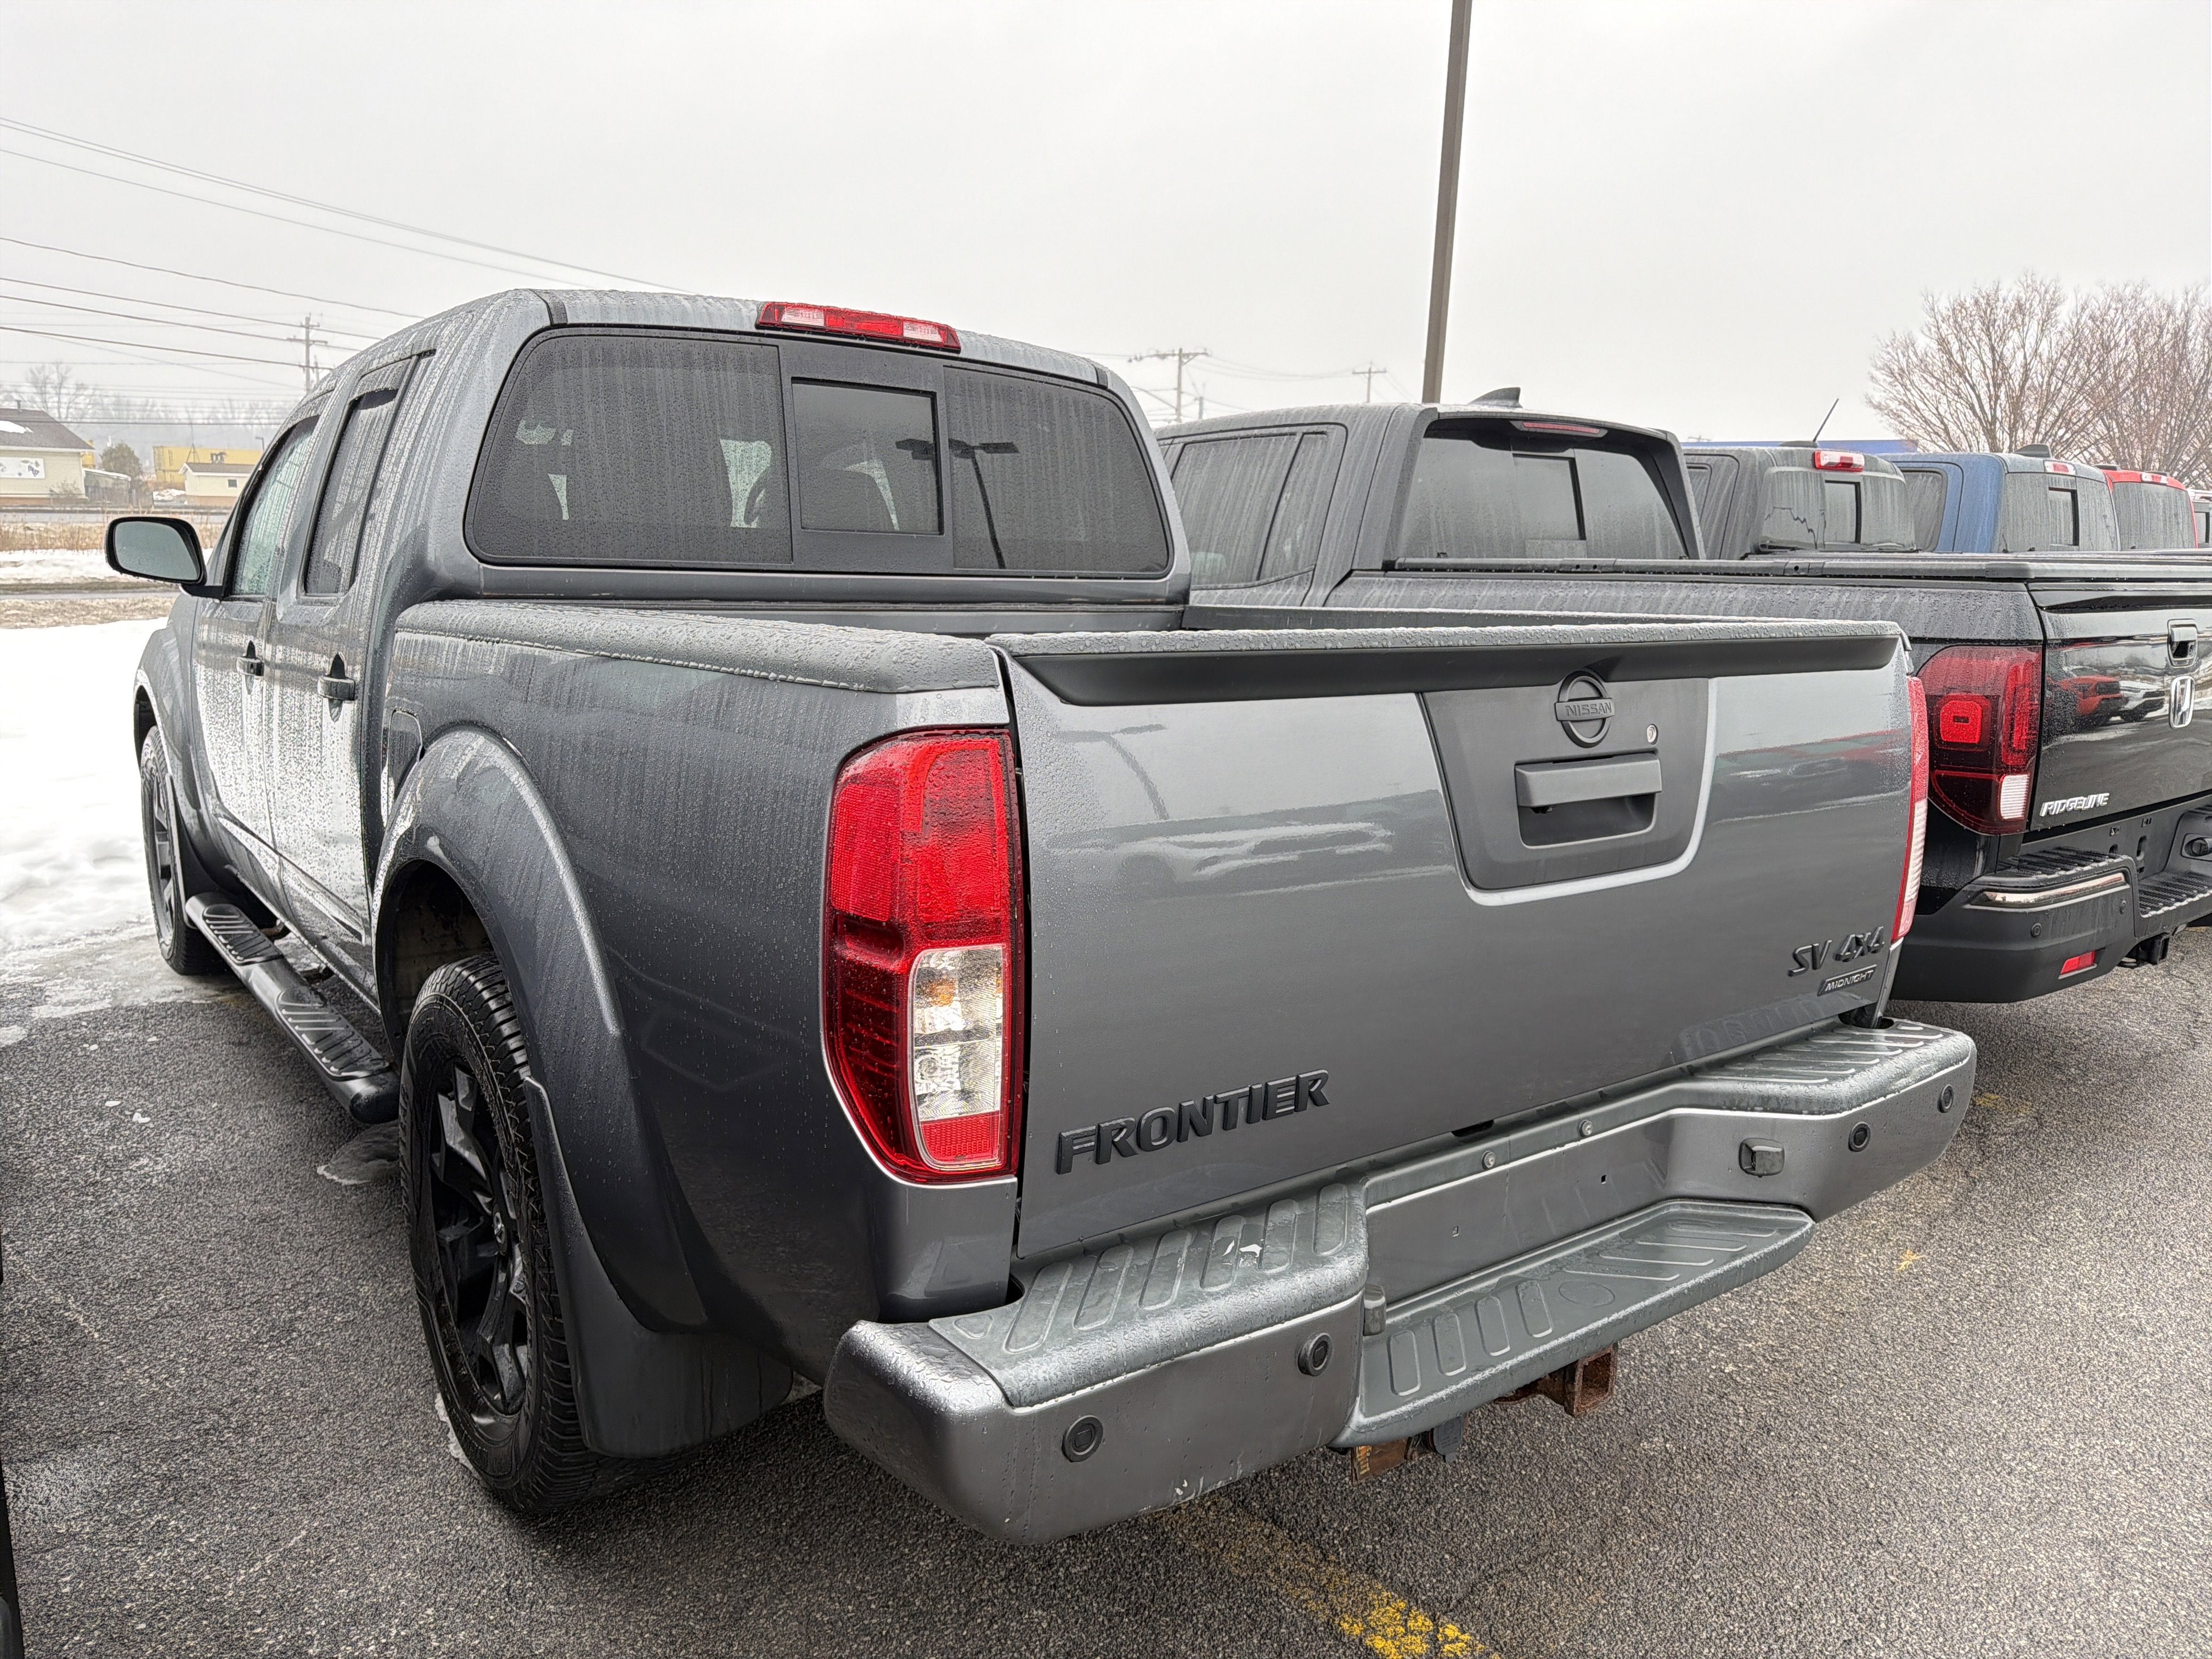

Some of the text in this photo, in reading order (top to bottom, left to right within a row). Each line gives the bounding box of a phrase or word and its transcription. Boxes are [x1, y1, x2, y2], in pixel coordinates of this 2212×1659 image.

[1565, 701, 1613, 717] NISSAN
[2039, 792, 2110, 817] RIDGELINE
[1787, 926, 1885, 977] SV 4X4
[1824, 969, 1874, 992] MIDNIGHT
[1056, 1069, 1330, 1175] FRONTIER
